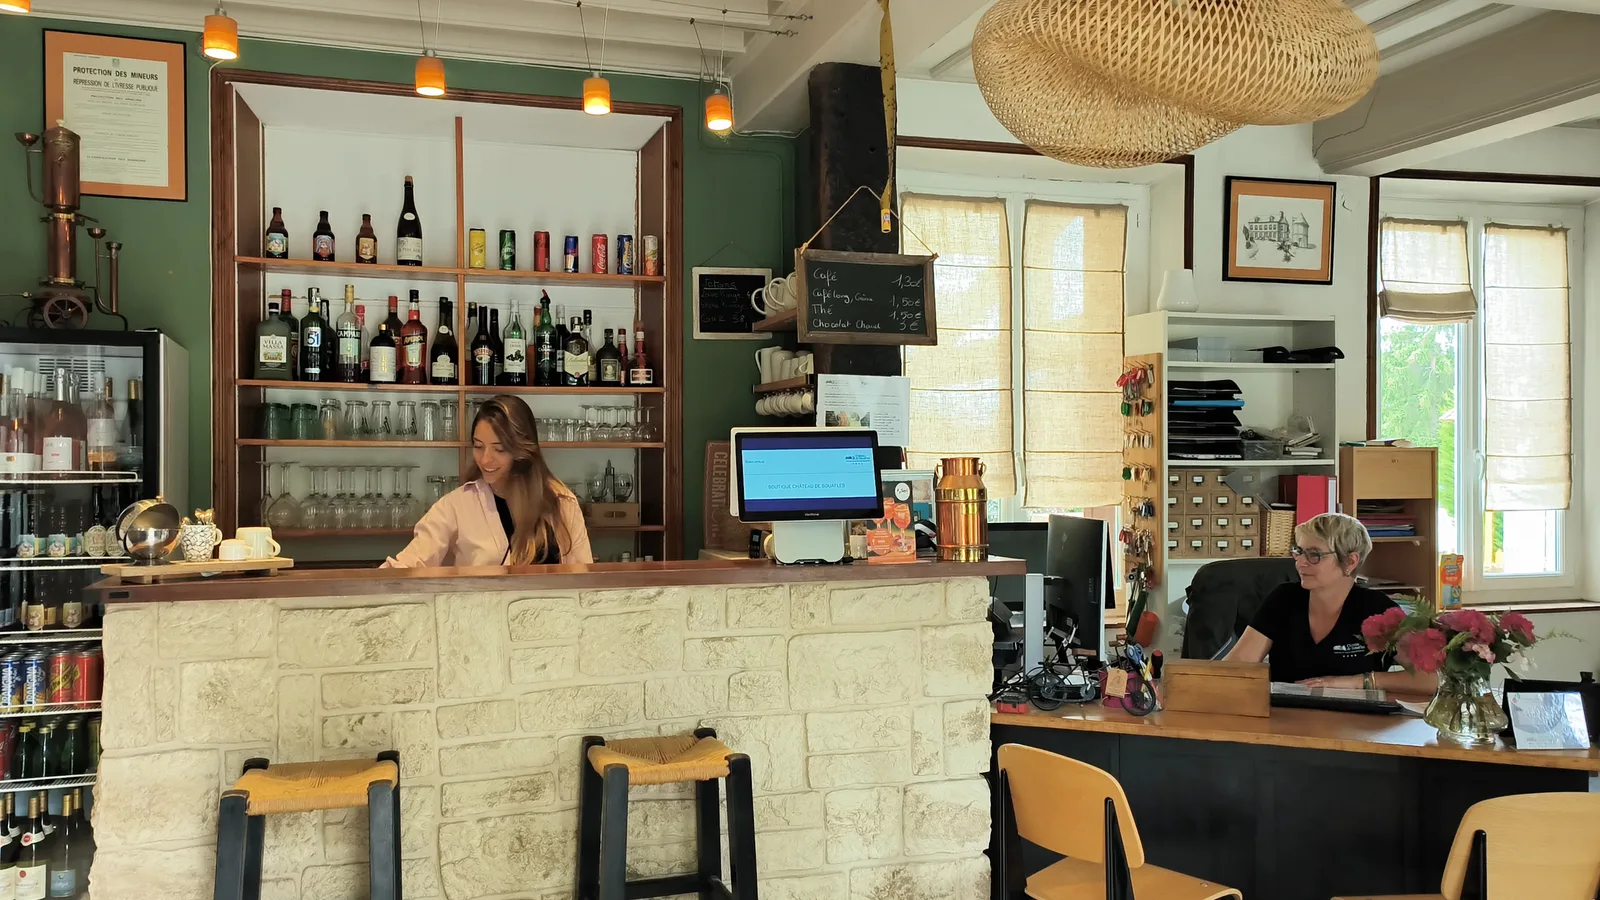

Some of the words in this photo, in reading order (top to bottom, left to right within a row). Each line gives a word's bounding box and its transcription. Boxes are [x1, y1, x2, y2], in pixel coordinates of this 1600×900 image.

[72, 66, 112, 77] PROTECTION
[115, 70, 127, 78] DES
[130, 72, 158, 80] MINEURS
[112, 81, 134, 90] L'IVRESSE
[136, 84, 158, 92] PUBLIQUE
[813, 267, 837, 287] Café
[812, 288, 832, 303] Café
[811, 303, 833, 315] Thé
[812, 319, 851, 328] Chocolat
[855, 320, 881, 329] Chaud
[307, 333, 319, 346] 51
[337, 330, 360, 338] CAMPARI
[25, 666, 37, 705] ORANGINA
